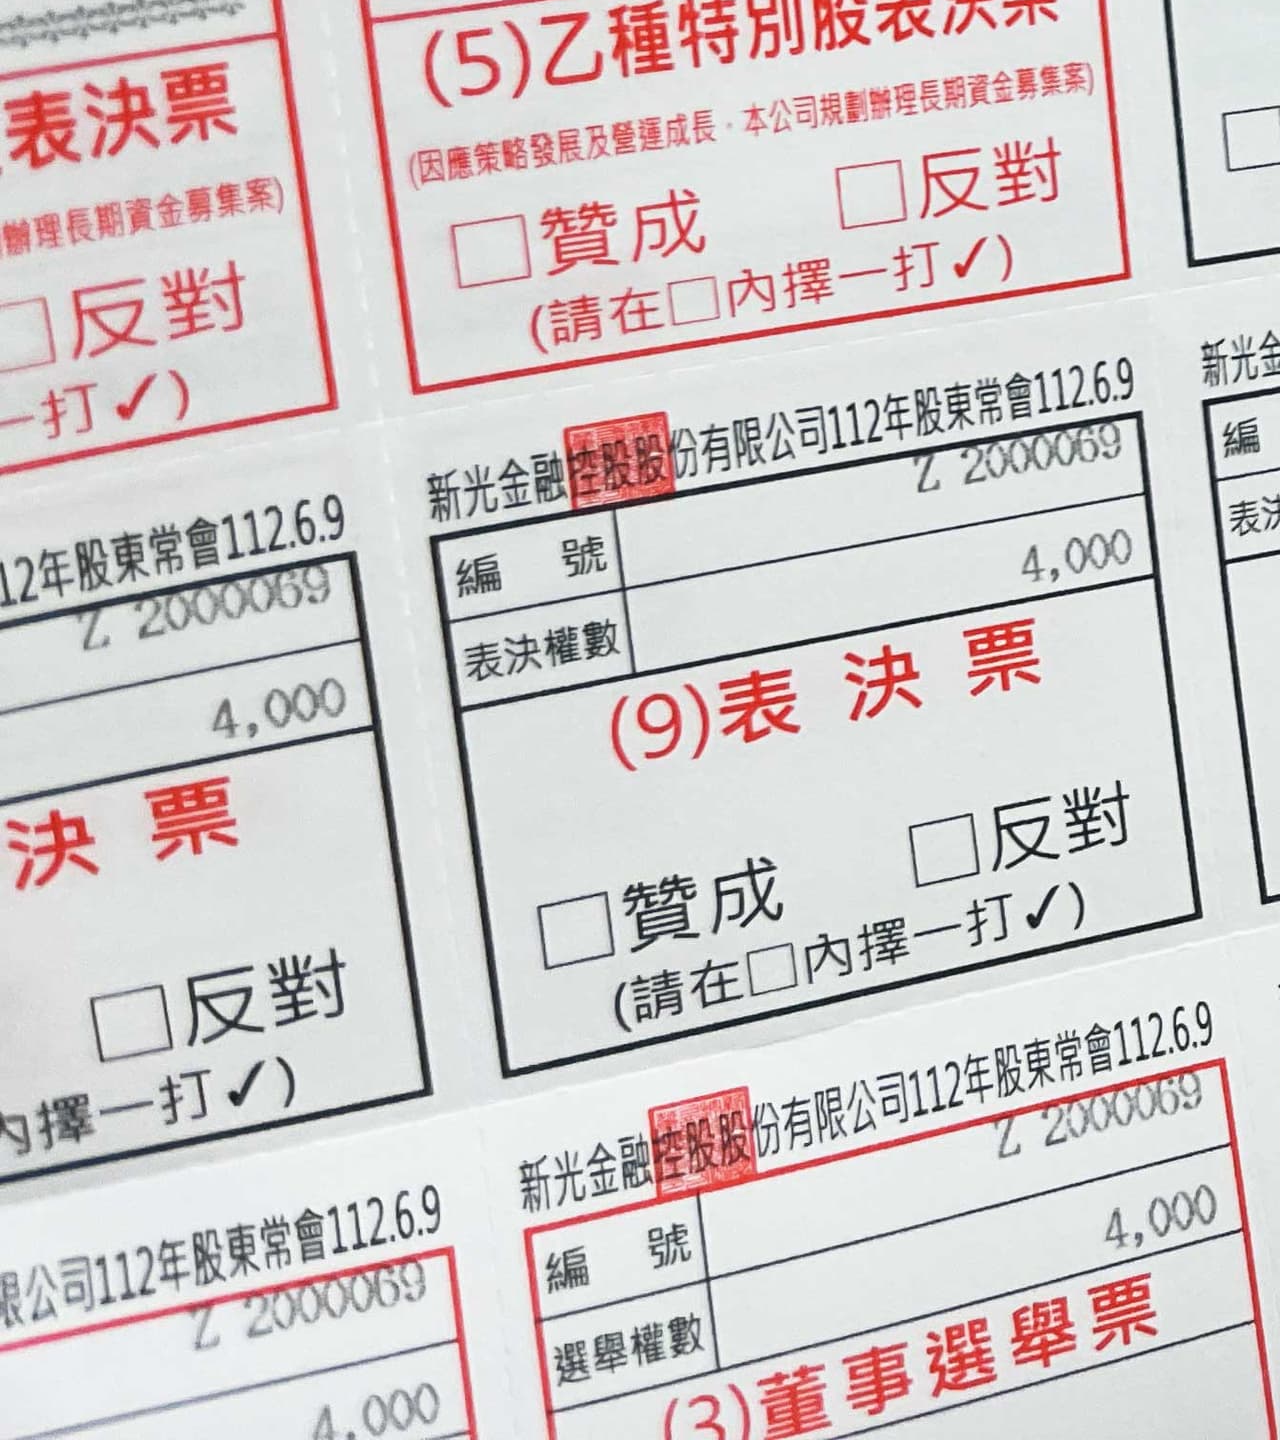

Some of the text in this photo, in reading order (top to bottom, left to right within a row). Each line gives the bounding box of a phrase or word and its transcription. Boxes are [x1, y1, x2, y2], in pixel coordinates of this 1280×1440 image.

[920, 137, 1063, 219] 反對
[541, 188, 706, 276] 贊成
[72, 260, 245, 360] 反對
[963, 424, 1122, 484] 2000069
[1021, 529, 1133, 583] 4,000
[135, 565, 331, 639] 2000069
[464, 619, 622, 682] 表決權數
[212, 677, 347, 739] 4,000
[991, 780, 1131, 872] 反對
[623, 858, 784, 954] 贊成
[187, 948, 348, 1048] 反對
[1042, 1071, 1202, 1148] 2000069
[1104, 1184, 1216, 1249] 4,000
[245, 1259, 426, 1338] 2000069
[553, 1312, 705, 1385] 選舉權數
